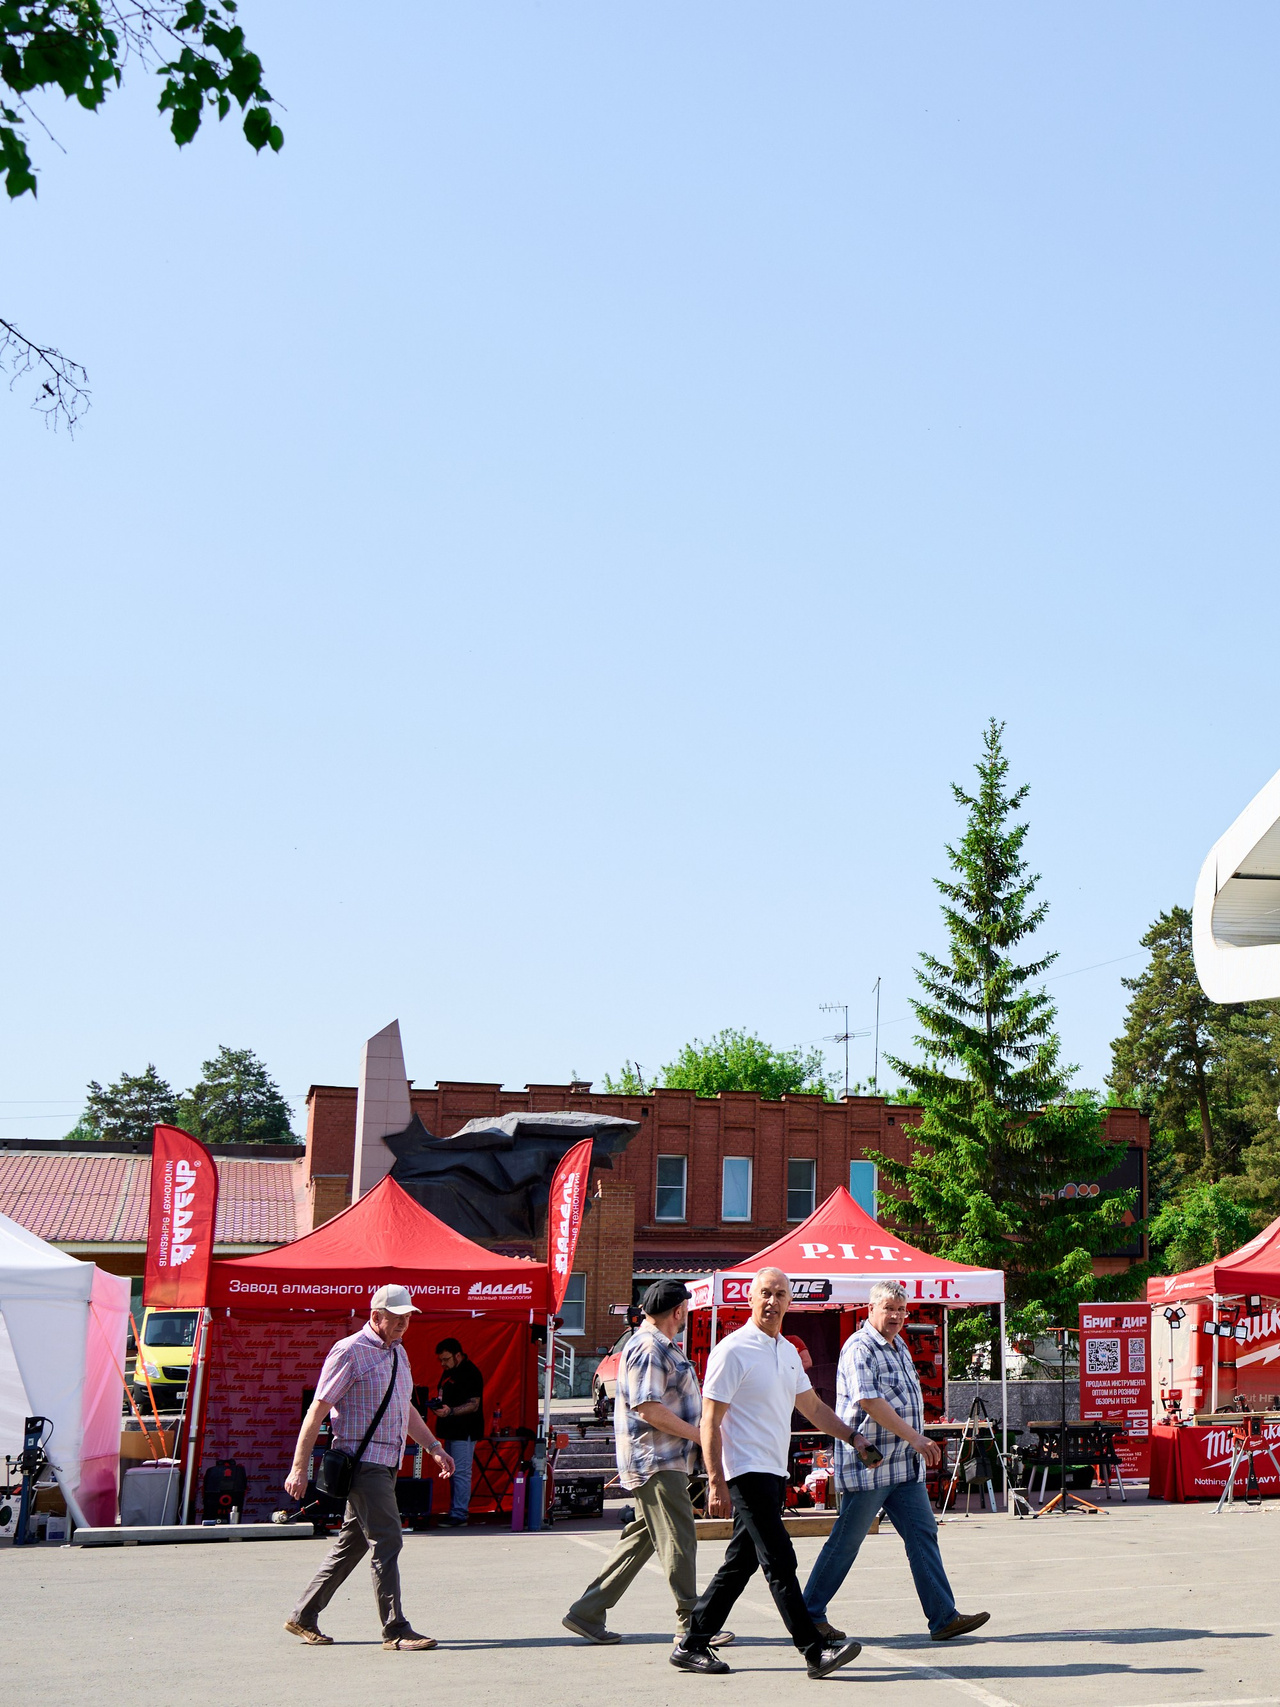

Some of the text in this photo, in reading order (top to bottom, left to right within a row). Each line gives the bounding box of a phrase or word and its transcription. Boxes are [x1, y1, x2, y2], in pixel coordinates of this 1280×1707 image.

[571, 1172, 581, 1225] технологии
[799, 1243, 912, 1261] P.I.T.
[229, 1279, 278, 1295] Завод
[282, 1283, 363, 1295] алмазного
[482, 1284, 533, 1295] АДЕЛЬ
[790, 1281, 826, 1293] NE
[1086, 1379, 1146, 1388] ПРОДАЖА ИНСТРУМЕНТА
[1118, 1388, 1140, 1396] РОЗНИЦУ
[1194, 1478, 1227, 1487] Nothing
